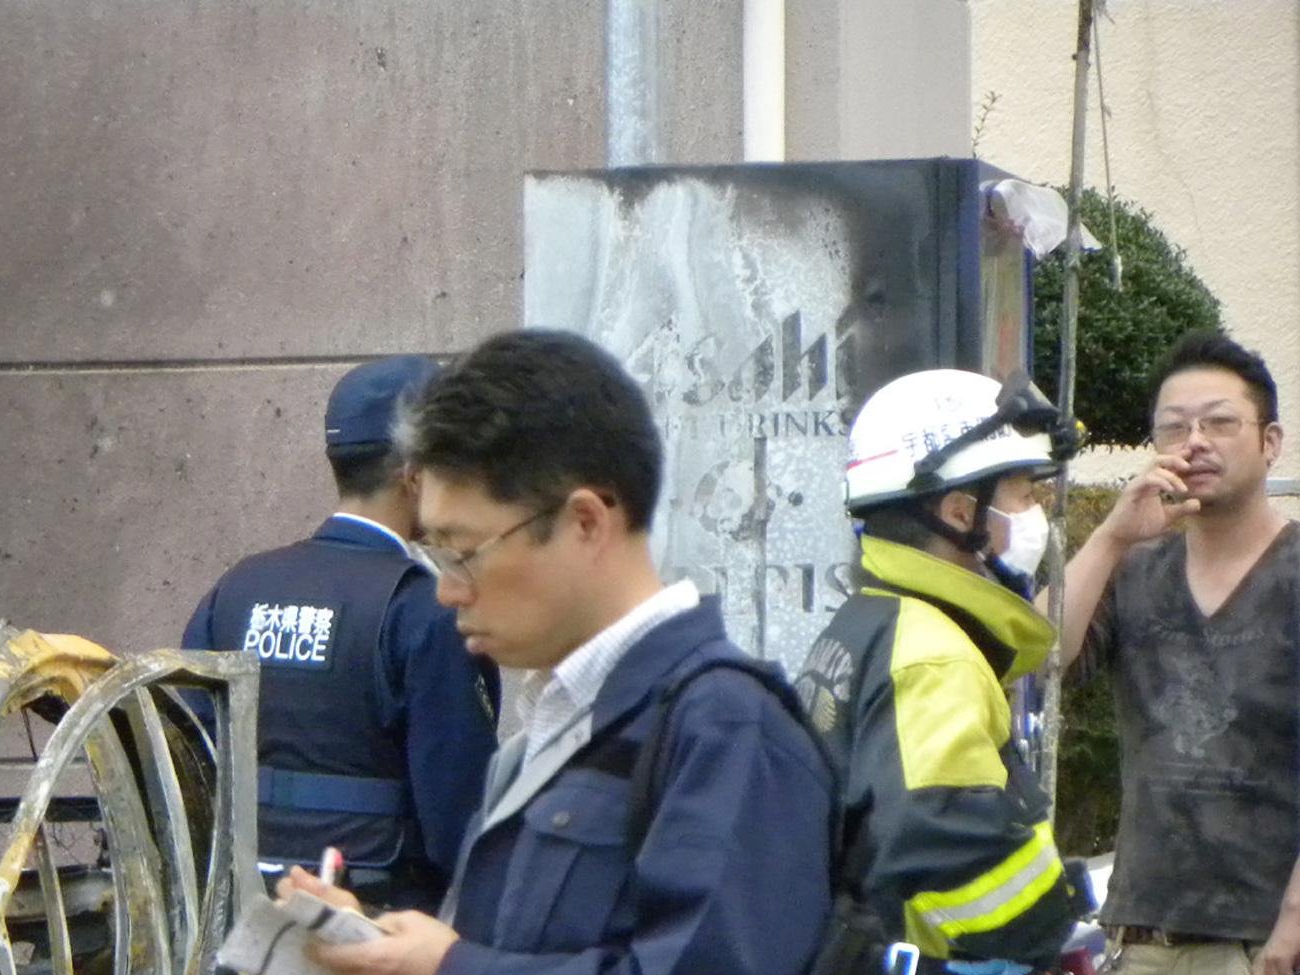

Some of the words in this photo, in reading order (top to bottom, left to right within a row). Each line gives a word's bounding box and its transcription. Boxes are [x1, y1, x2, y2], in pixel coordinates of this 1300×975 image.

[250, 603, 333, 633] 栃木県警察
[244, 629, 329, 660] POLICE
